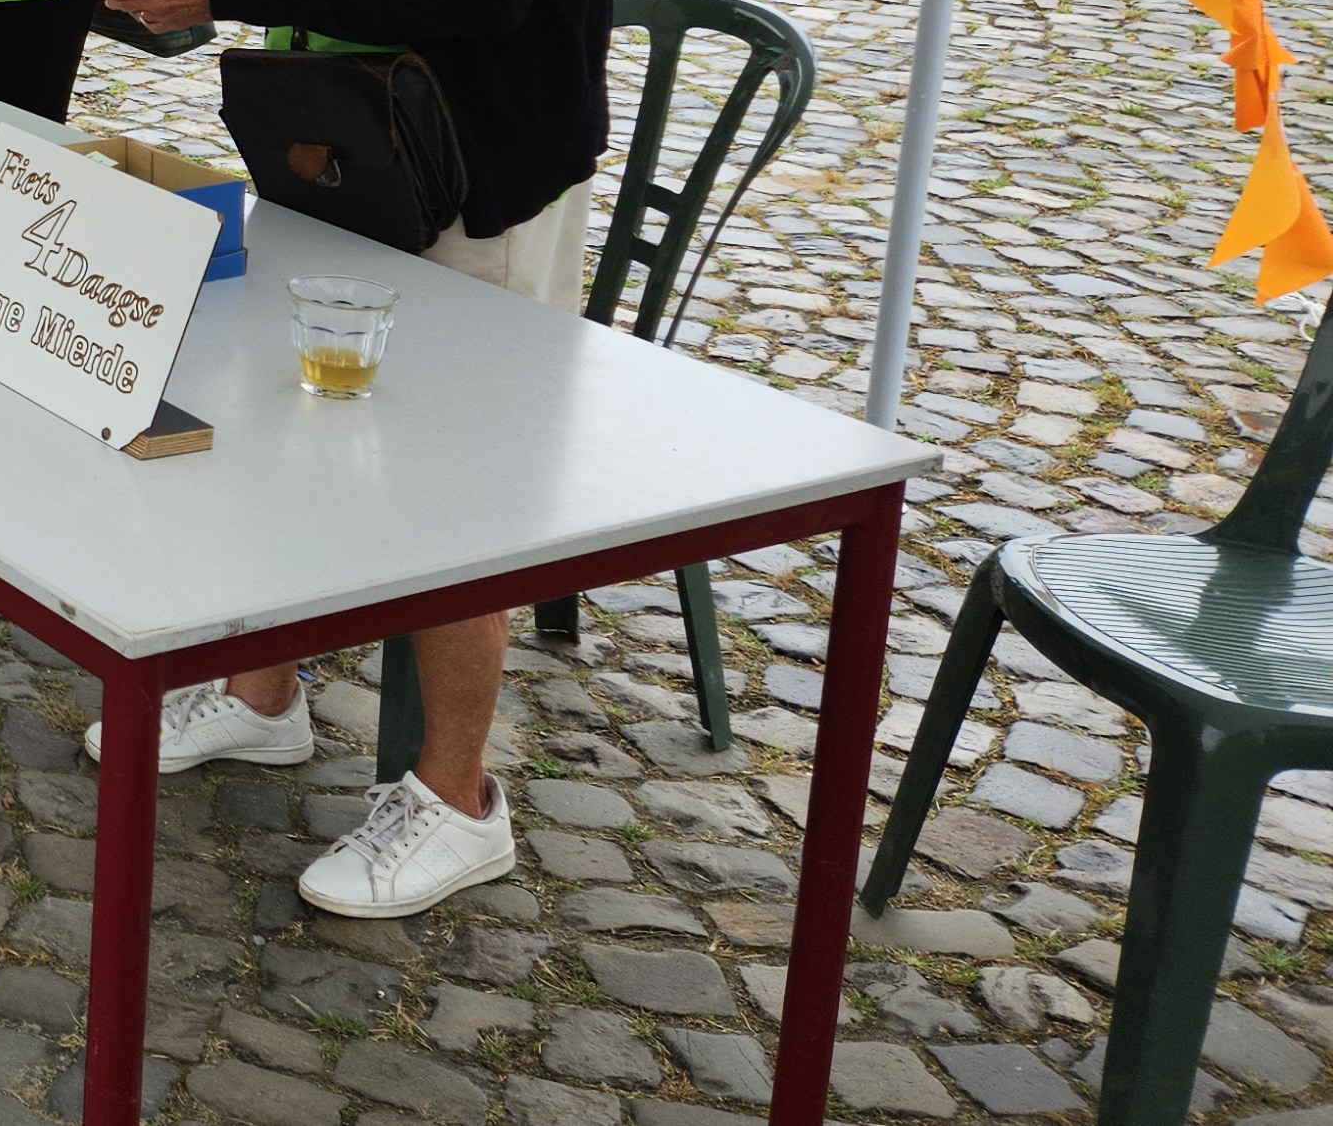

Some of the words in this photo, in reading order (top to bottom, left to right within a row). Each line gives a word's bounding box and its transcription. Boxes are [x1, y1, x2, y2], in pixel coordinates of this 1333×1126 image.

[20, 198, 79, 277] 4
[51, 246, 166, 330] Daagse
[30, 304, 140, 395] Mierde
